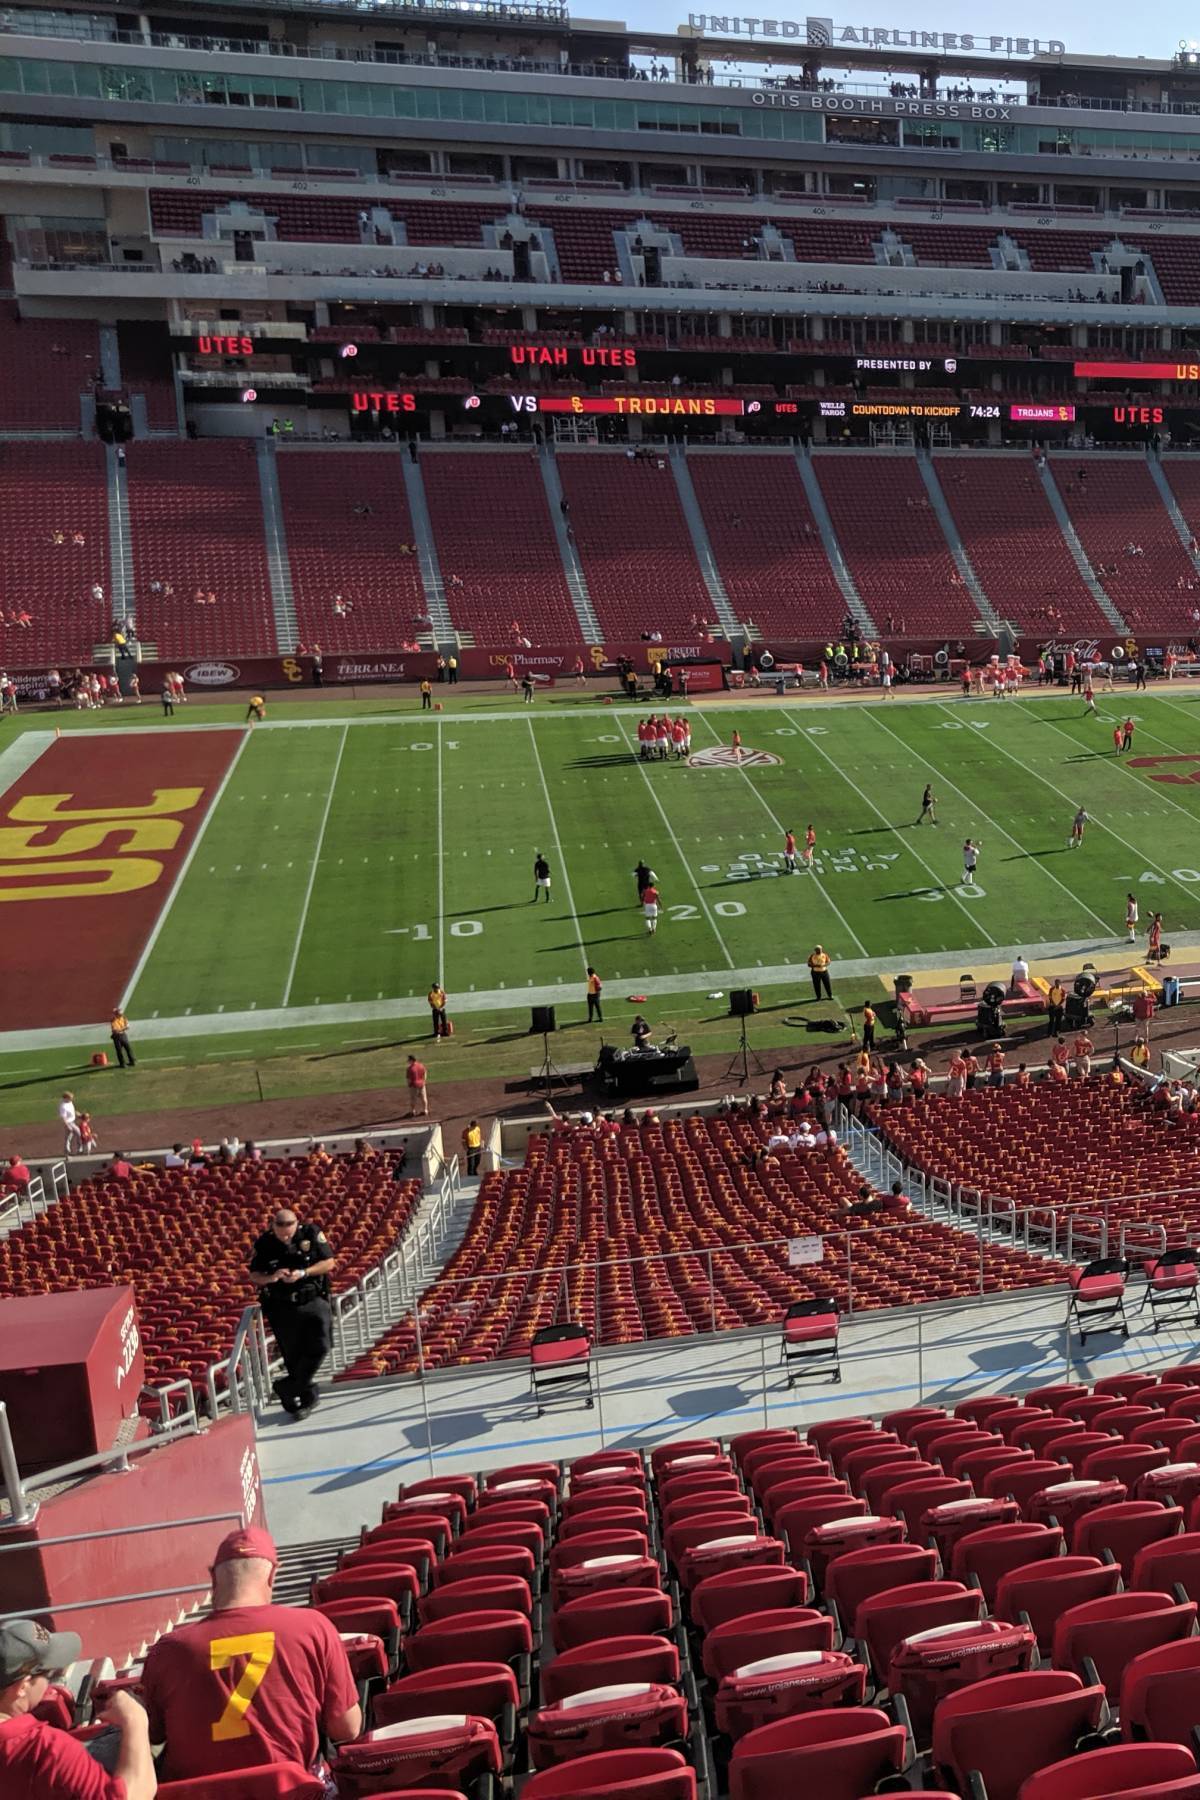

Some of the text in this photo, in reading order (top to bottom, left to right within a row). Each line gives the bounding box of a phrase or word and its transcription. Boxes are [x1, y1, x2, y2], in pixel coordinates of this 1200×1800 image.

[689, 13, 1066, 56] UNITED AIRLINES FIELD
[752, 92, 1011, 120] OTIS BOOTH PRESS BOX
[199, 336, 254, 354] UTES
[511, 346, 636, 366] UTAH UTES
[857, 359, 916, 371] PRESENTED
[919, 360, 932, 371] BY
[353, 394, 415, 412] UTES
[511, 396, 537, 412] VS
[615, 398, 715, 415] TROJANS
[775, 403, 797, 413] UTES
[820, 402, 845, 410] WELLS
[853, 405, 960, 417] COUNTDOWN TO KICKOFF
[970, 406, 1000, 418] 74:24
[1018, 409, 1053, 418] TROJANS
[1114, 406, 1163, 424] UTES
[337, 663, 406, 674] TERRANEA
[489, 654, 564, 667] USC Pharmacy
[700, 852, 900, 871] AIRLNES
[667, 901, 747, 921] 20
[411, 920, 483, 941] 10
[210, 1631, 275, 1743] 7
